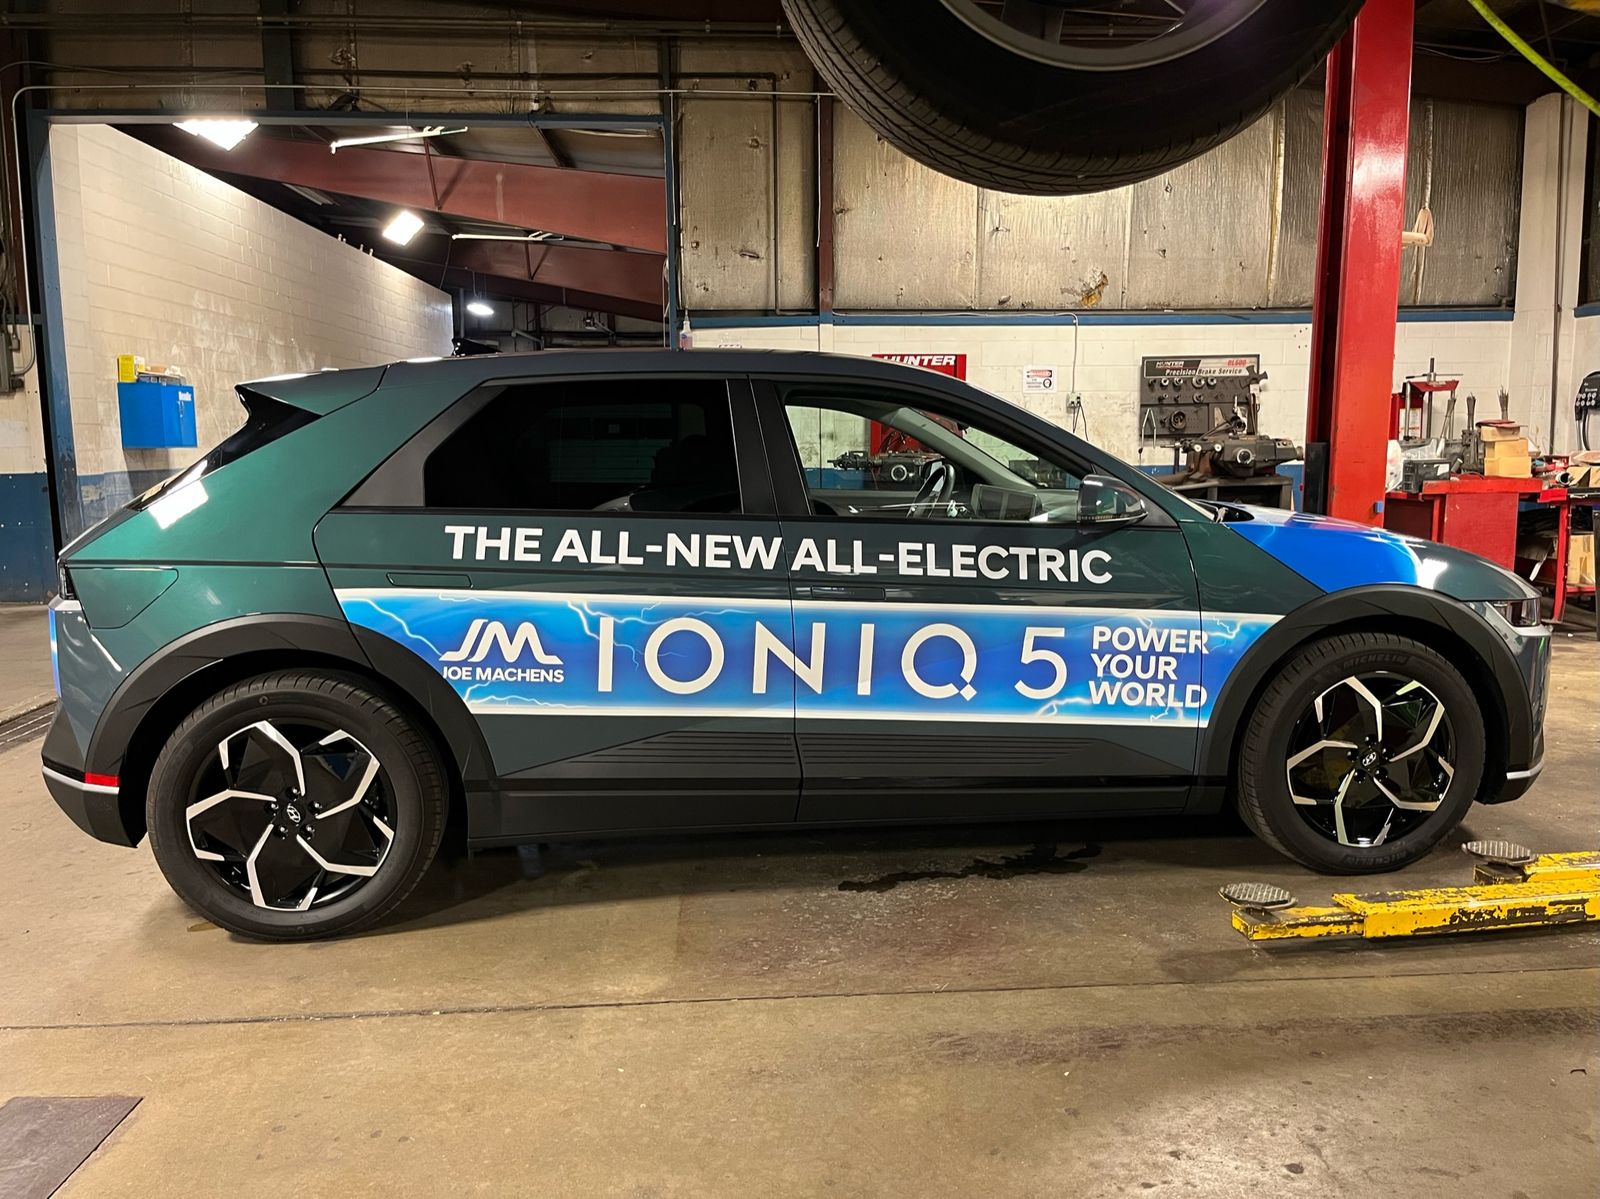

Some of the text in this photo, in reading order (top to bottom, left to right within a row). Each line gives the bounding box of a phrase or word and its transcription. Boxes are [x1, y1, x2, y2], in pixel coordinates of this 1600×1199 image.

[1165, 368, 1196, 376] Precision
[444, 525, 1113, 584] THE ALL-NEW ALL-ELECTRIC
[1091, 626, 1210, 655] POWER
[597, 615, 1068, 701] IONIQ 5
[1090, 652, 1178, 681] YOUR
[442, 666, 566, 683] JOE MACHENS
[1089, 680, 1208, 708] WORLD
